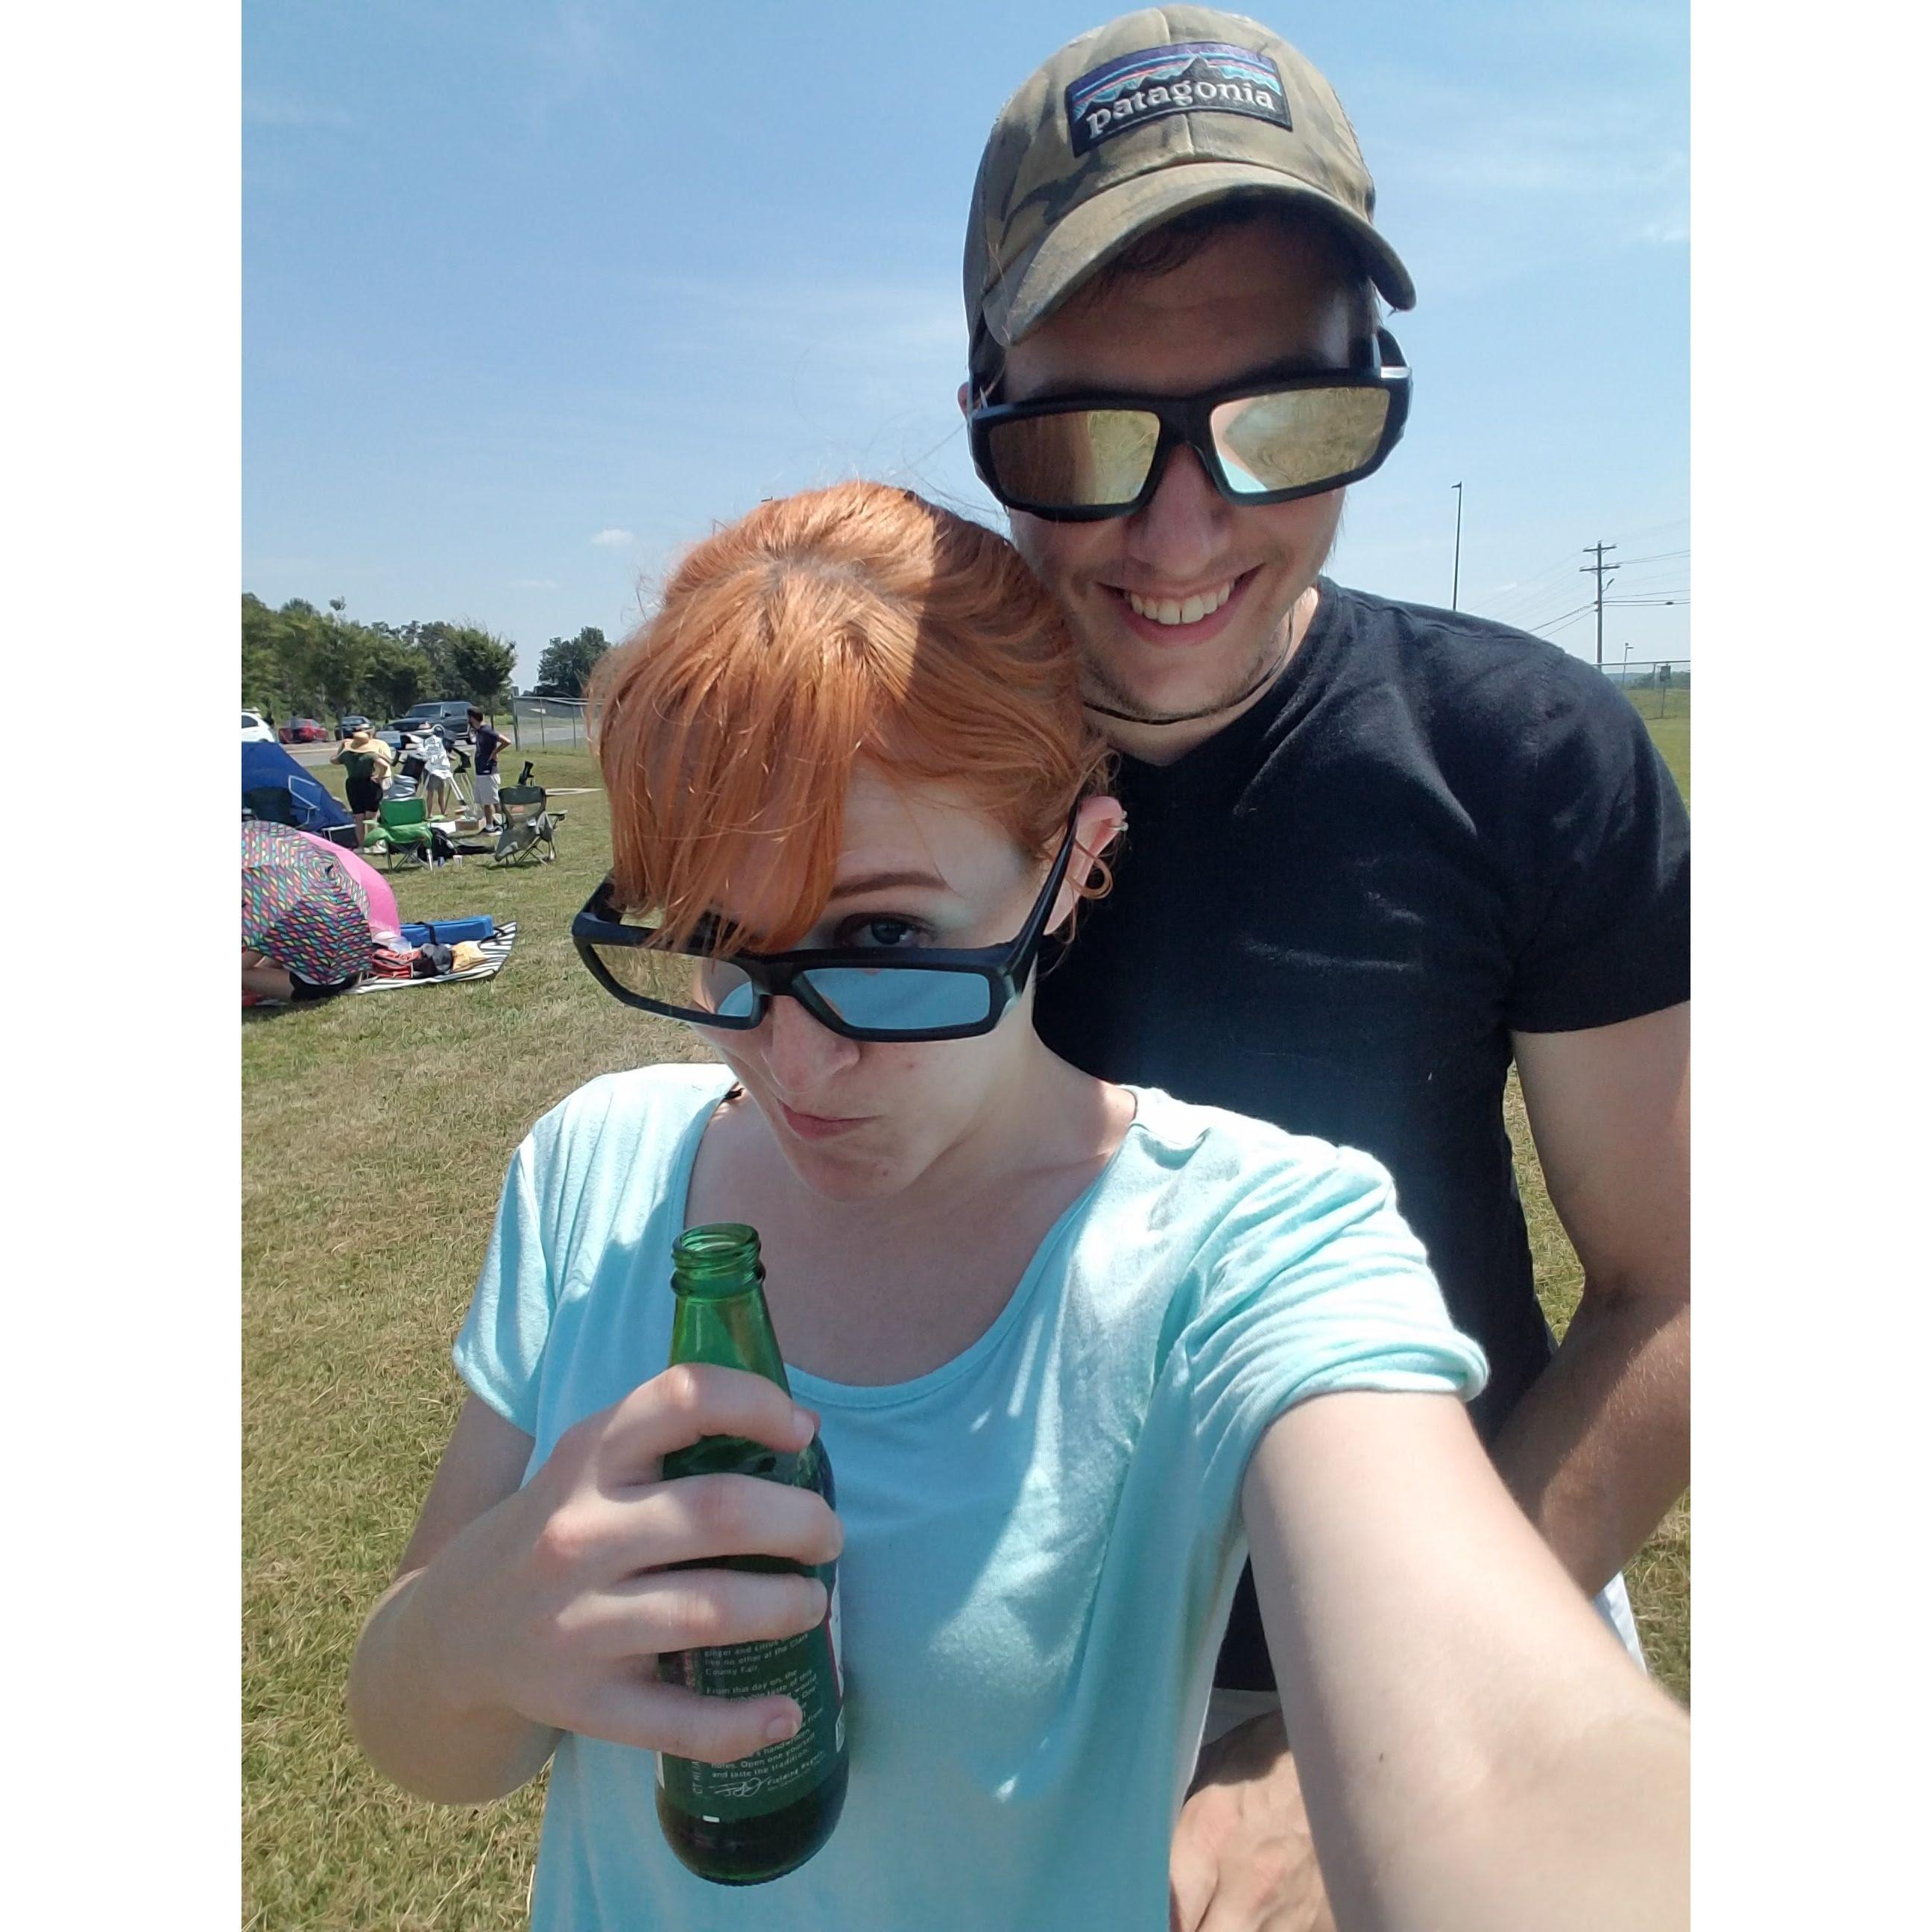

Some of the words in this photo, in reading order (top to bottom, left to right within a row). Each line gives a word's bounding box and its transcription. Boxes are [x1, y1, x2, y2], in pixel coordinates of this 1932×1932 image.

[1086, 73, 1275, 131] patagonia
[738, 1654, 761, 1664] other
[705, 1667, 738, 1676] County
[707, 1686, 730, 1695] From
[733, 1685, 749, 1693] that
[752, 1682, 767, 1691] day
[740, 1759, 765, 1769] Open
[768, 1752, 783, 1762] one
[711, 1770, 728, 1778] and
[730, 1770, 752, 1778] taste
[754, 1767, 769, 1776] the
